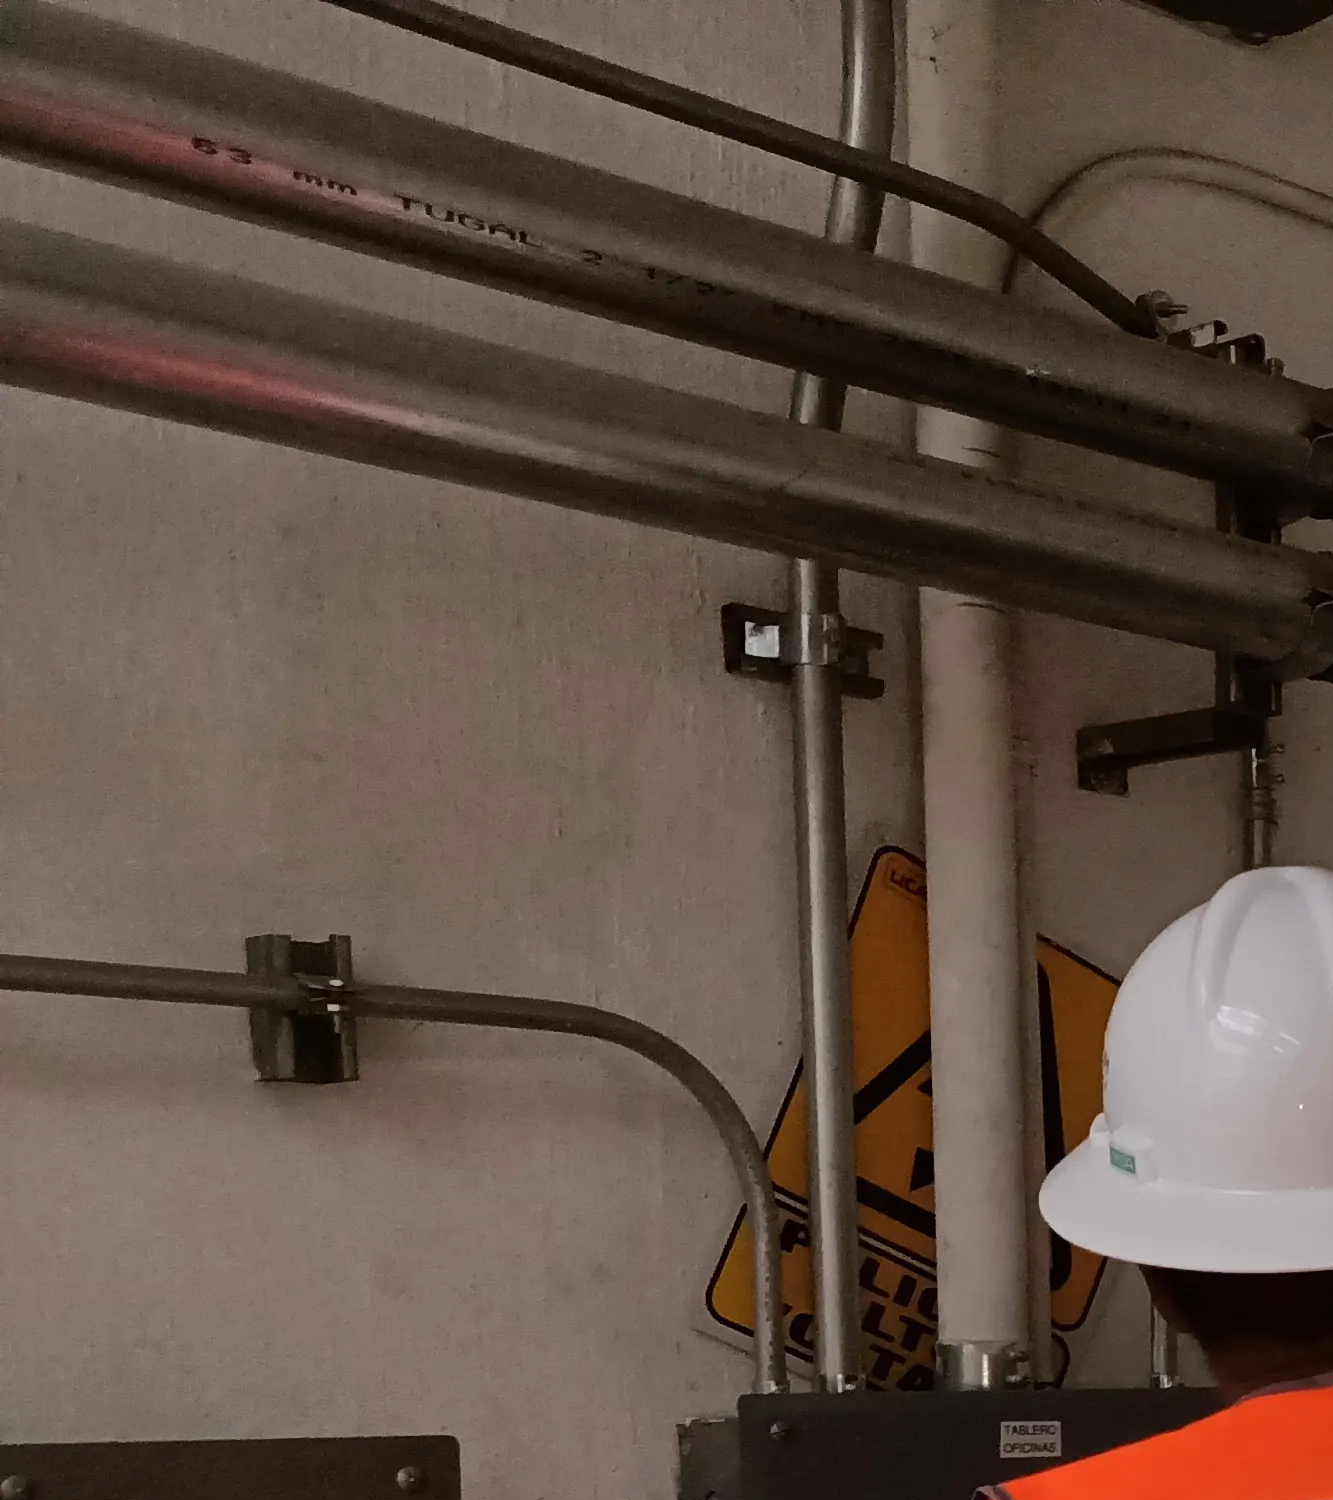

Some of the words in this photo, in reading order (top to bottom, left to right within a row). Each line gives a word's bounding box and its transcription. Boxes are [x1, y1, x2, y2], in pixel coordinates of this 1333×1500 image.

[292, 170, 357, 195] mm
[1003, 1424, 1056, 1436] TABLERO
[1002, 1442, 1057, 1454] OFICINAS
